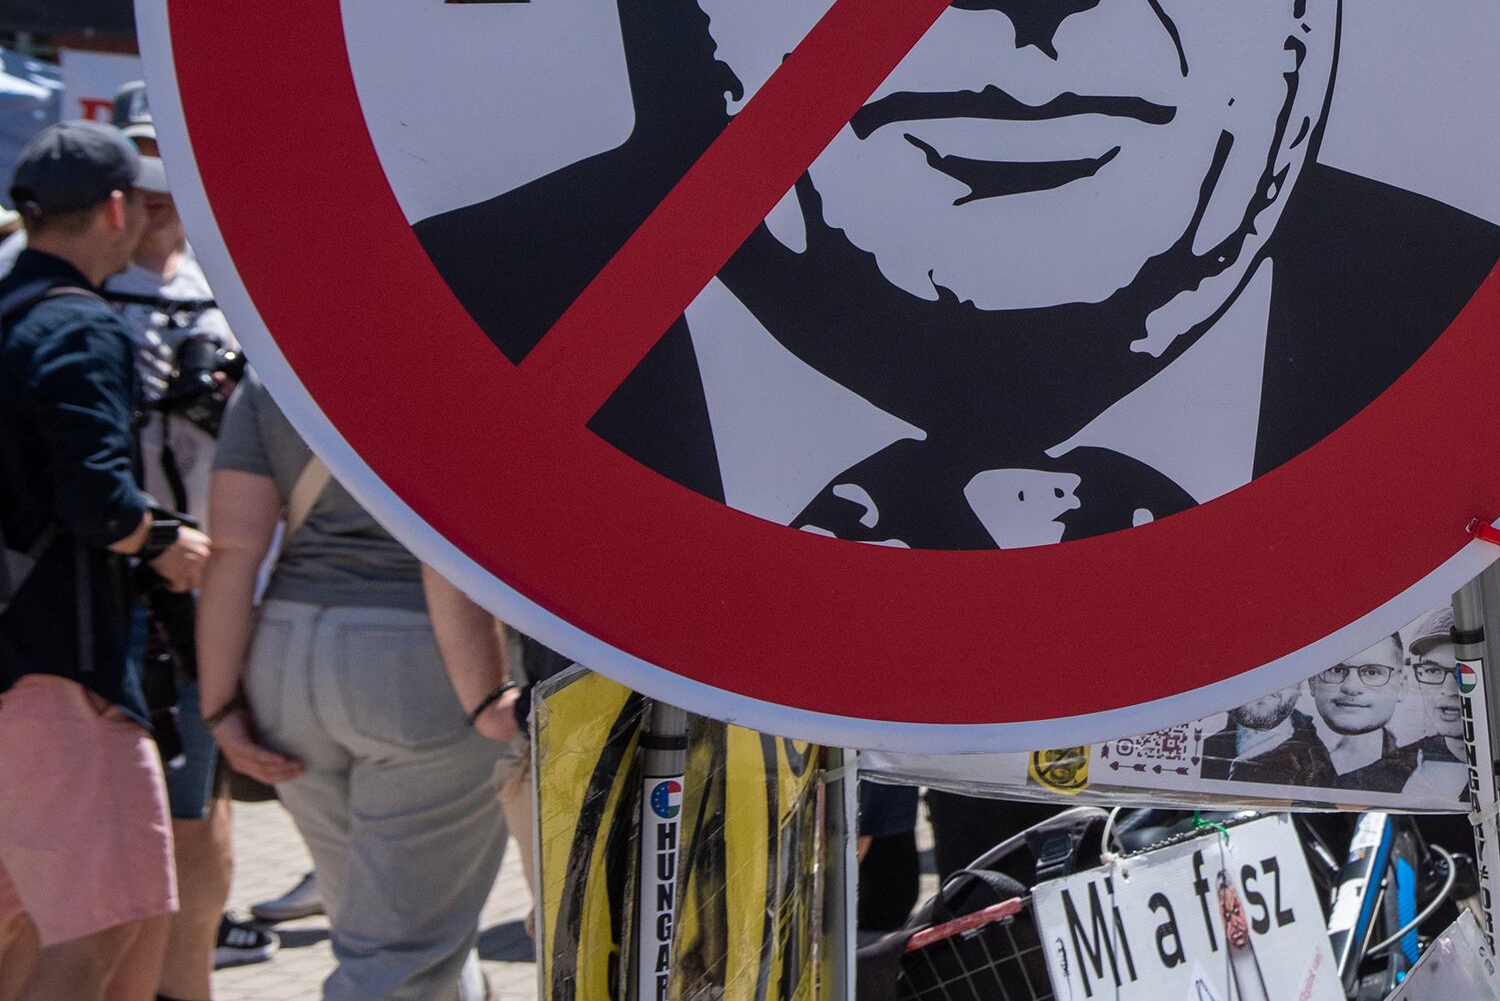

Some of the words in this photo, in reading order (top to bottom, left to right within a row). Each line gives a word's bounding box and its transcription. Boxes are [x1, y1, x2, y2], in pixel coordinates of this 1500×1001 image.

[1060, 875, 1138, 998] Mi
[1148, 891, 1187, 969] a
[1192, 848, 1298, 953] fsz
